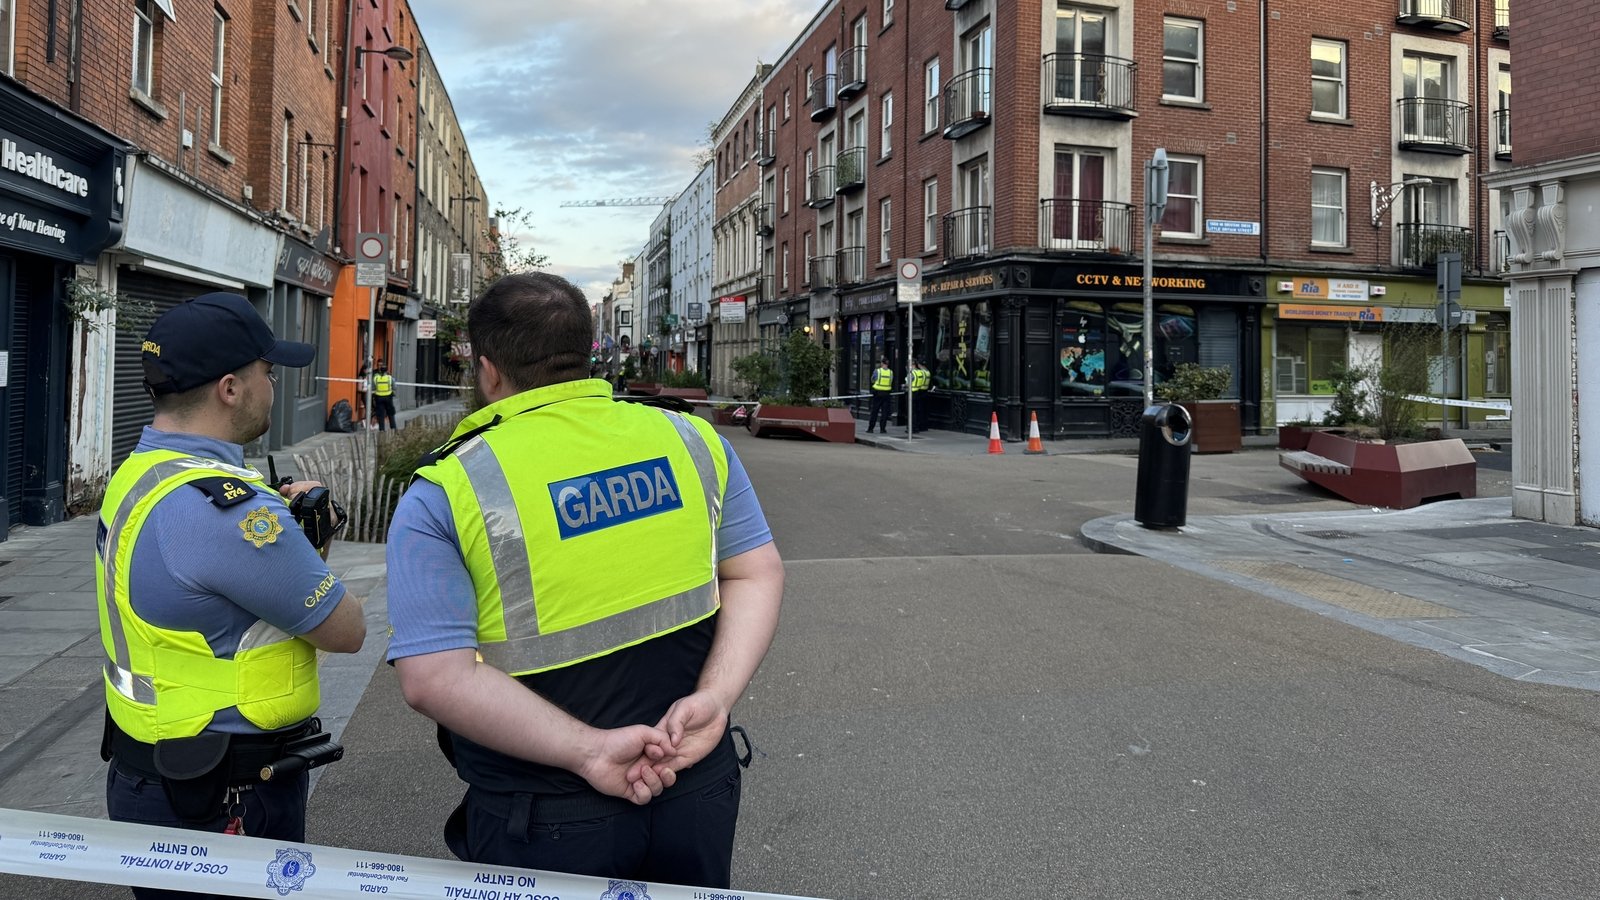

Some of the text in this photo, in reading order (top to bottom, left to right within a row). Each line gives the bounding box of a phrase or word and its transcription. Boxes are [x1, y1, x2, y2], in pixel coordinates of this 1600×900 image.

[2, 138, 88, 197] Healthcare
[7, 212, 18, 231] of
[18, 213, 36, 233] Your
[36, 219, 66, 244] Hearing
[940, 280, 959, 291] REPAIR
[965, 274, 993, 287] SERVICES
[1076, 274, 1206, 289] CCTV & NEWORKING
[1301, 280, 1320, 293] Ria
[1359, 310, 1375, 320] Ria
[223, 482, 234, 491] C
[224, 487, 247, 500] 174
[558, 466, 677, 528] GARDA
[304, 571, 336, 608] GARDA
[38, 830, 85, 841] 1800-666-111
[38, 852, 67, 861] GARDA
[149, 842, 208, 857] NO ENTRY
[119, 855, 229, 875] COSC AR IONTRÁIL
[355, 861, 405, 872] 1800-666-111
[473, 872, 536, 888] NO ENTRY
[359, 884, 389, 893] GARDA
